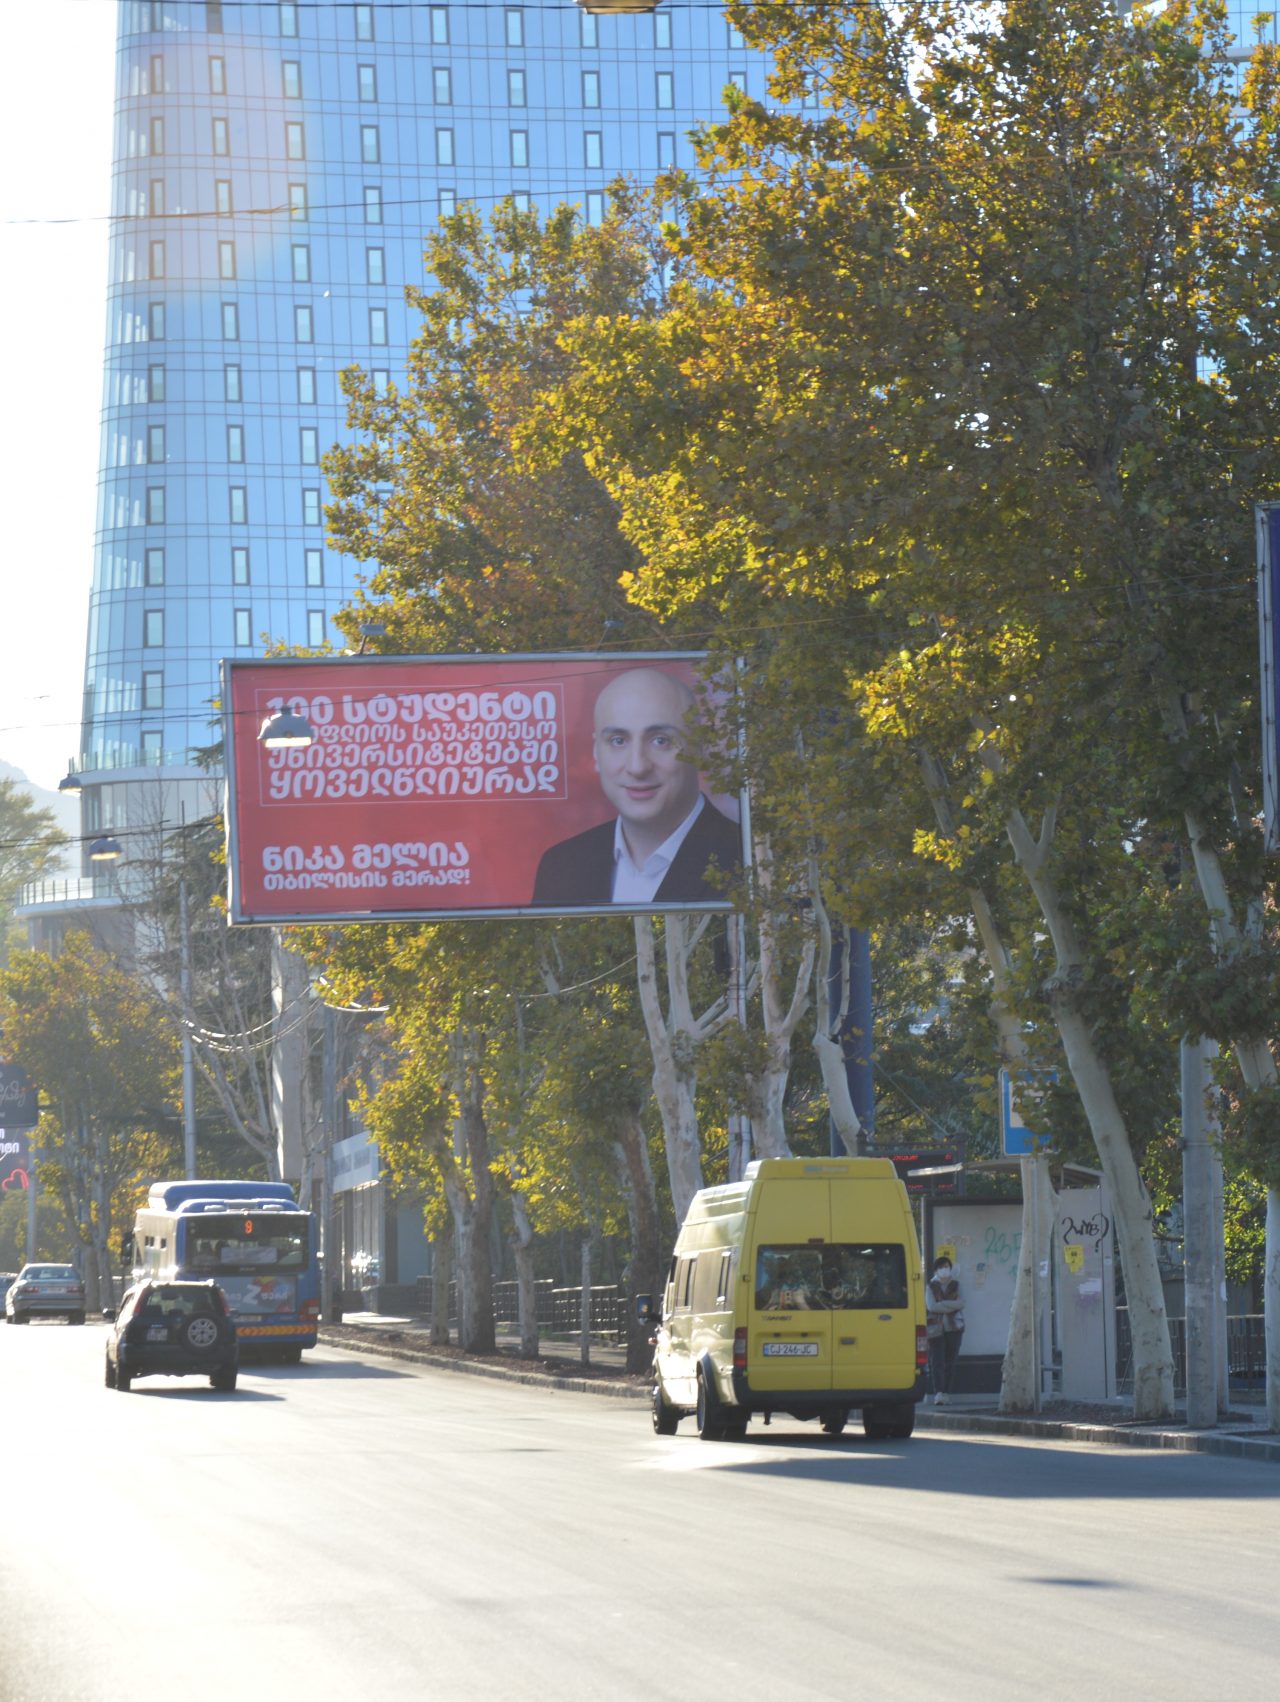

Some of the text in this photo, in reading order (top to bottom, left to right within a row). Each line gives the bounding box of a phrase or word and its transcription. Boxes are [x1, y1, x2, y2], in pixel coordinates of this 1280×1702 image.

[342, 691, 556, 724] სტუდენტი
[412, 720, 558, 742] საუკეთესო
[269, 740, 558, 768] უნივერსიტეტებში
[270, 765, 559, 799] ყოველწლიურად
[262, 841, 470, 872] ნიკა მელია
[263, 868, 471, 891] თბილისის მერად!
